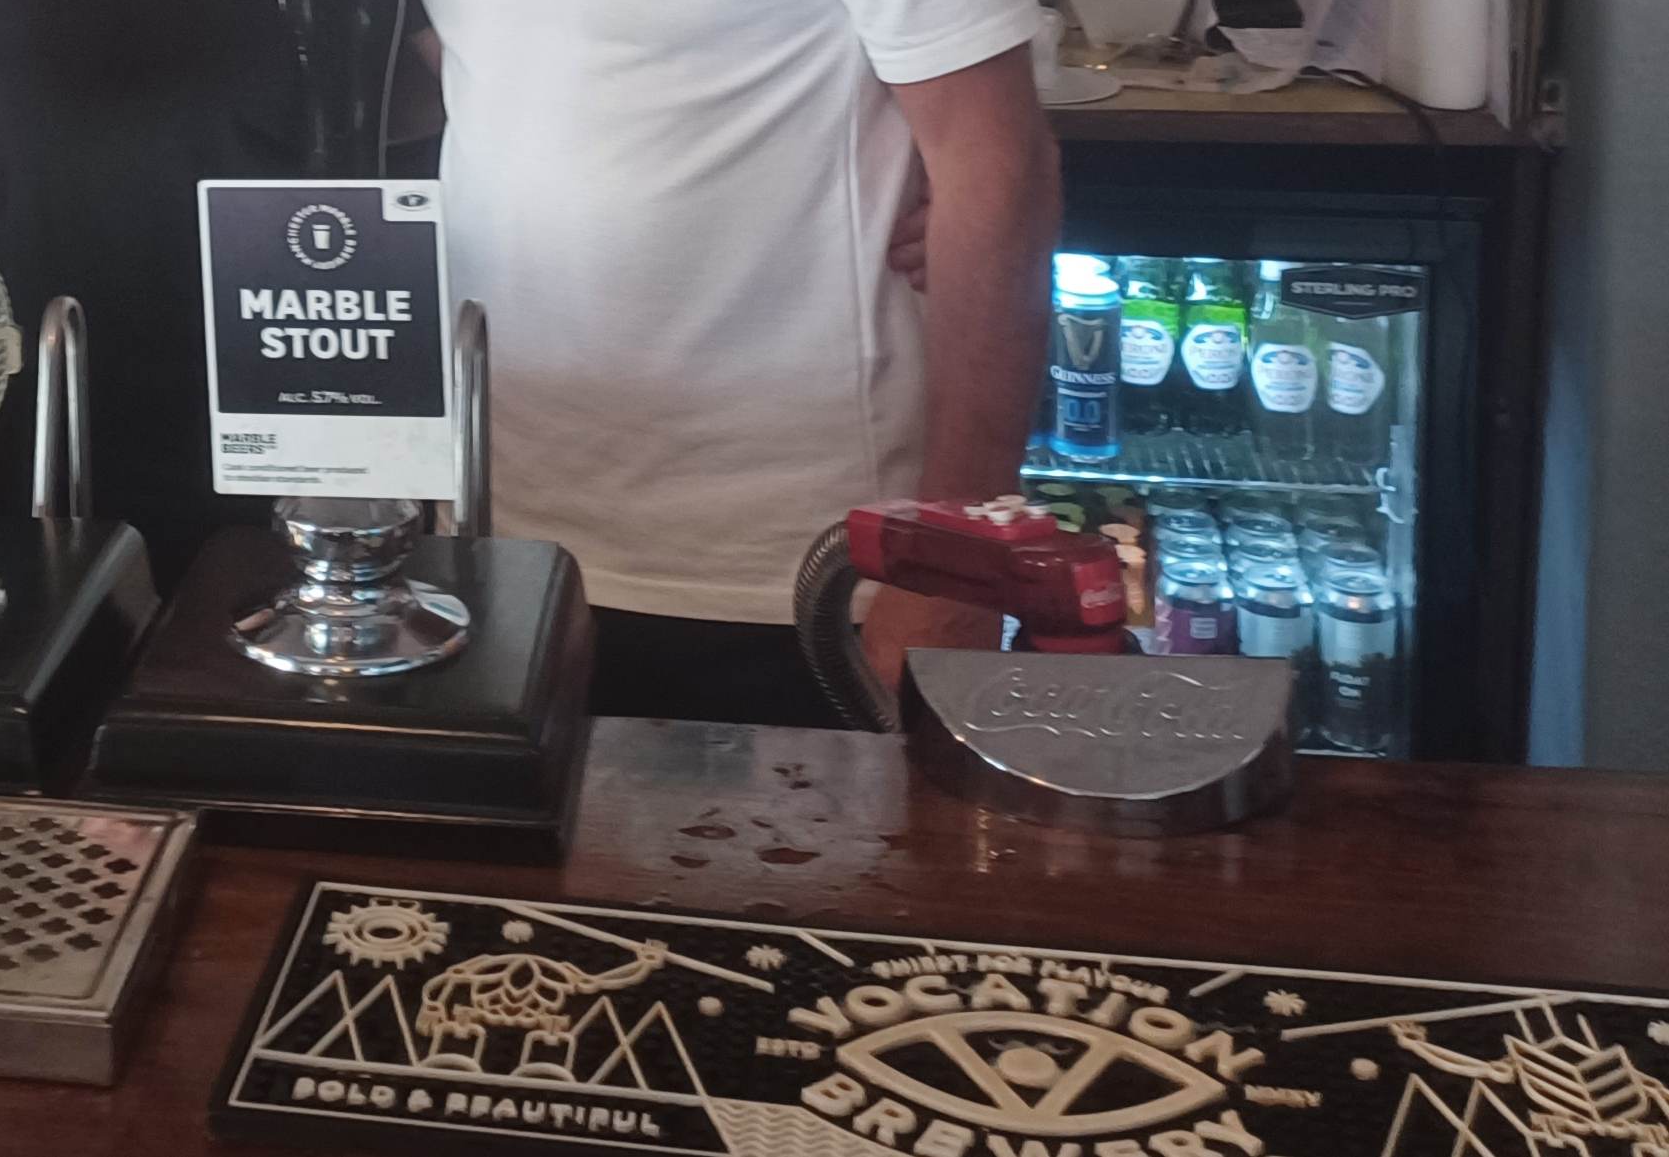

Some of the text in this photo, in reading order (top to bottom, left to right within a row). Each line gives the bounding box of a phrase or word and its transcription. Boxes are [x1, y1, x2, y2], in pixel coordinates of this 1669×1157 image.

[239, 288, 413, 322] MARBLE
[1289, 280, 1418, 300] STERLING PRO
[260, 327, 396, 360] STOUT
[1049, 364, 1117, 385] GUINNESS
[221, 432, 277, 445] MARBLE
[788, 972, 1266, 1079] VOCATION
[292, 1075, 662, 1138] BOLD & BEAUTIFUL
